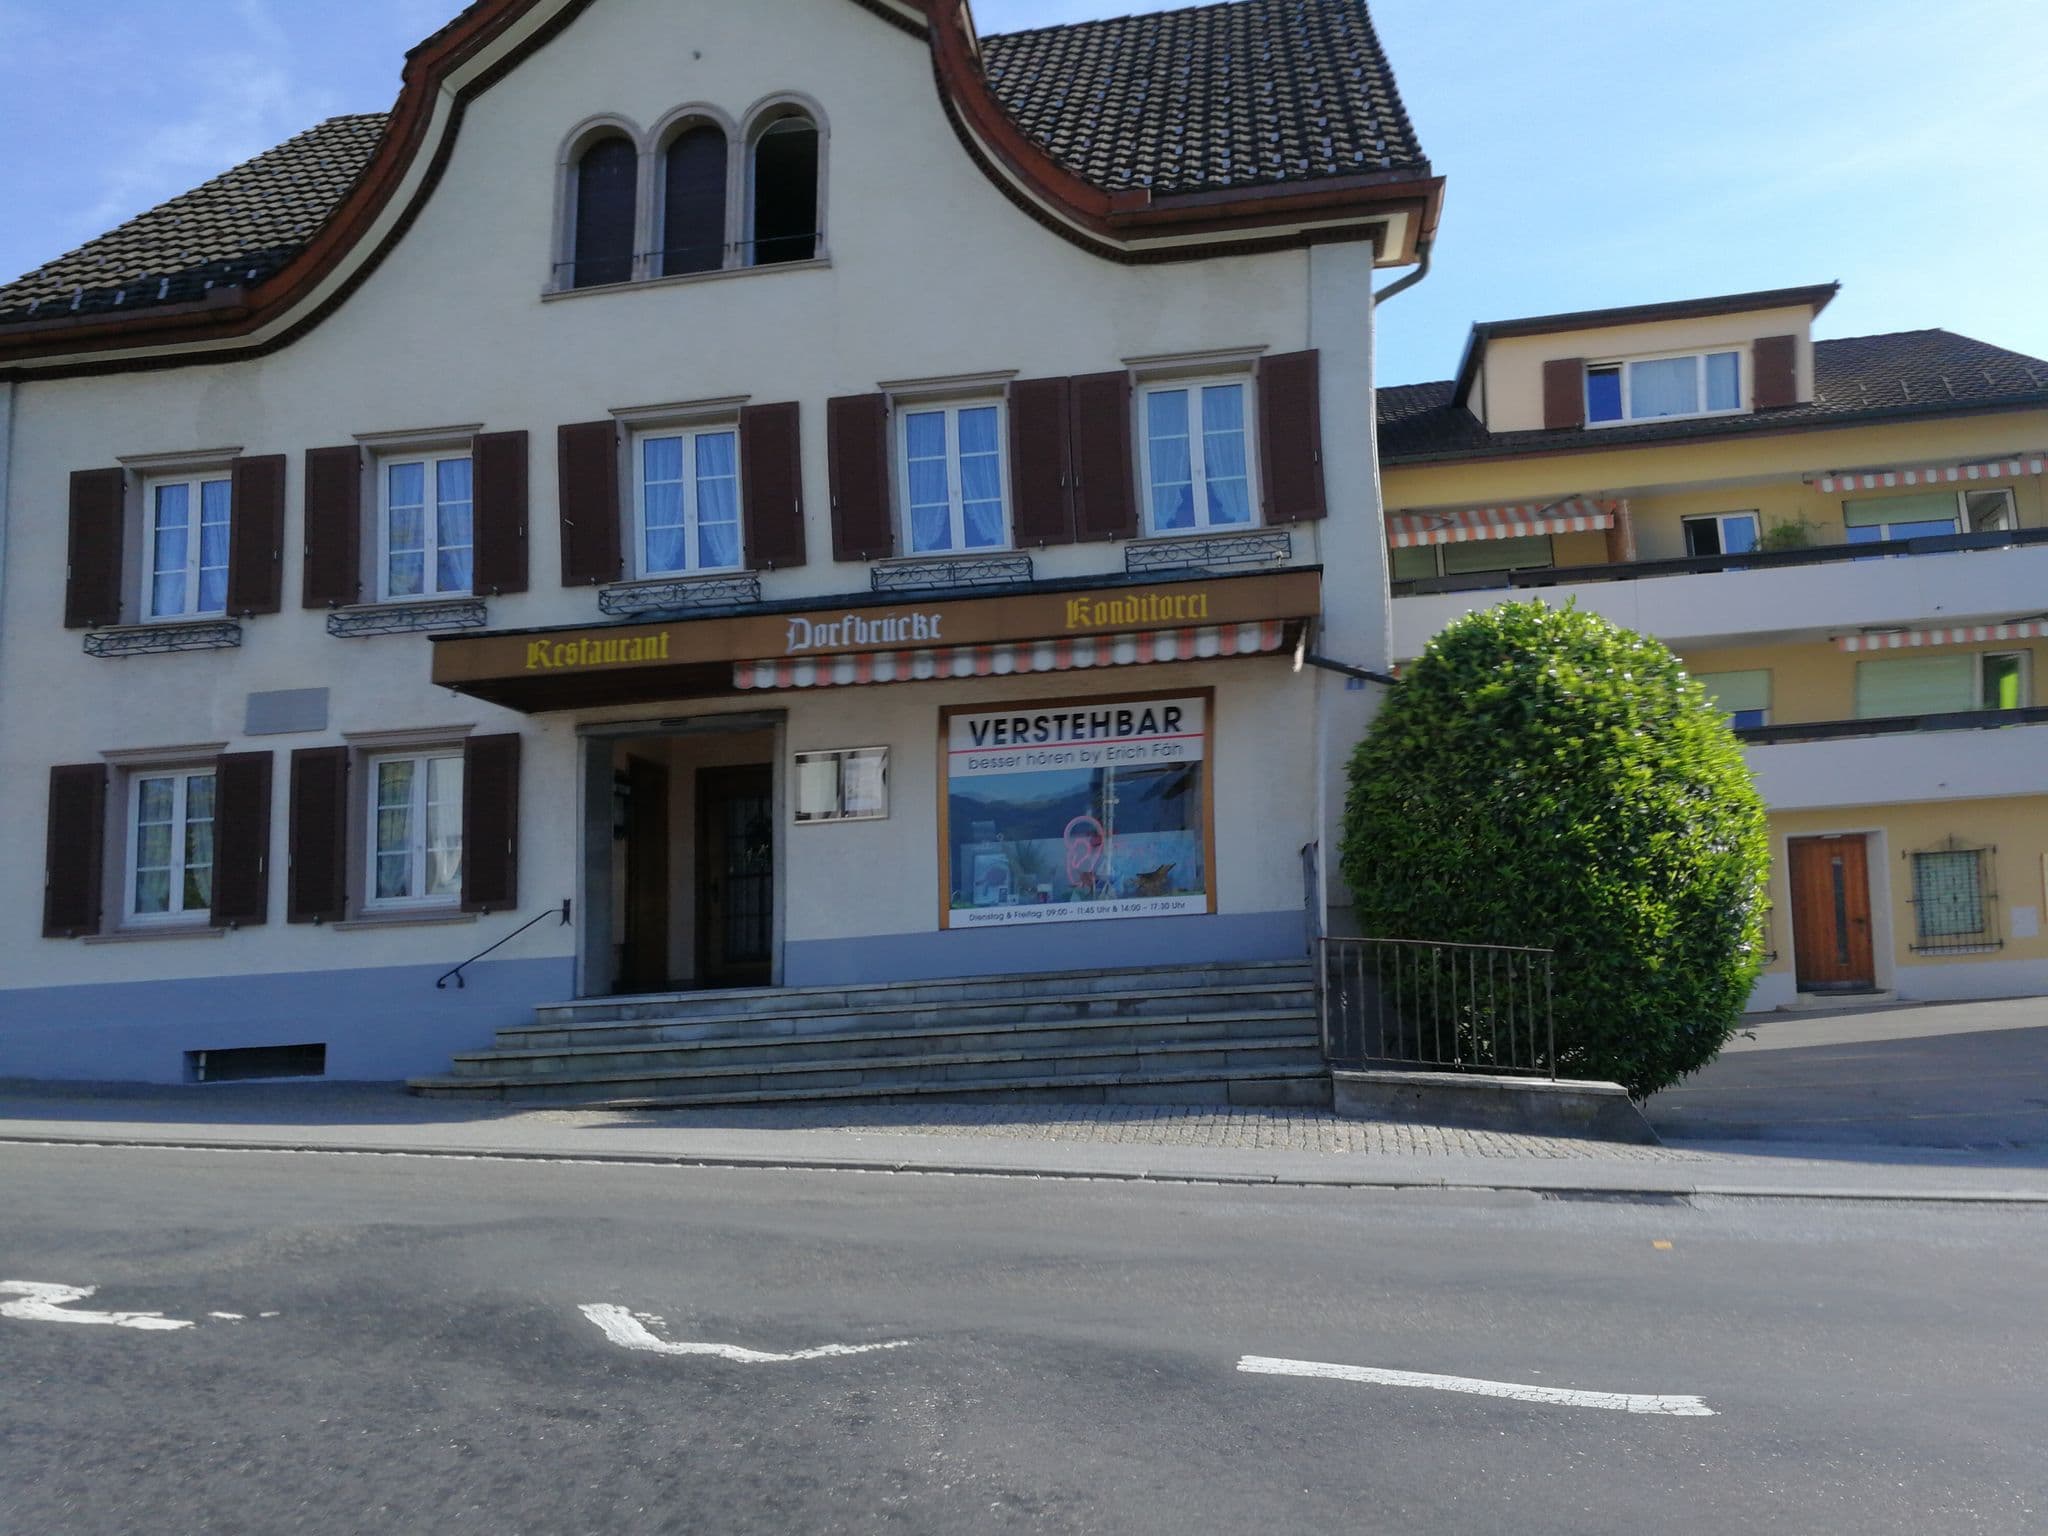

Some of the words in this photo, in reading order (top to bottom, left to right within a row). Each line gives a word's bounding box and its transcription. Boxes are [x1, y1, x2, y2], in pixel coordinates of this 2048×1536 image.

[526, 631, 670, 669] Restaurant
[1065, 590, 1208, 628] Konditorei
[969, 706, 1183, 746] VERSTEHBAR
[968, 756, 1021, 770] besser
[1025, 751, 1074, 766] hören
[1079, 749, 1102, 763] by
[1106, 745, 1146, 760] Erich
[969, 912, 1004, 921] Dienstag
[1097, 905, 1111, 913] Uhr
[1172, 901, 1185, 909] Uhr
